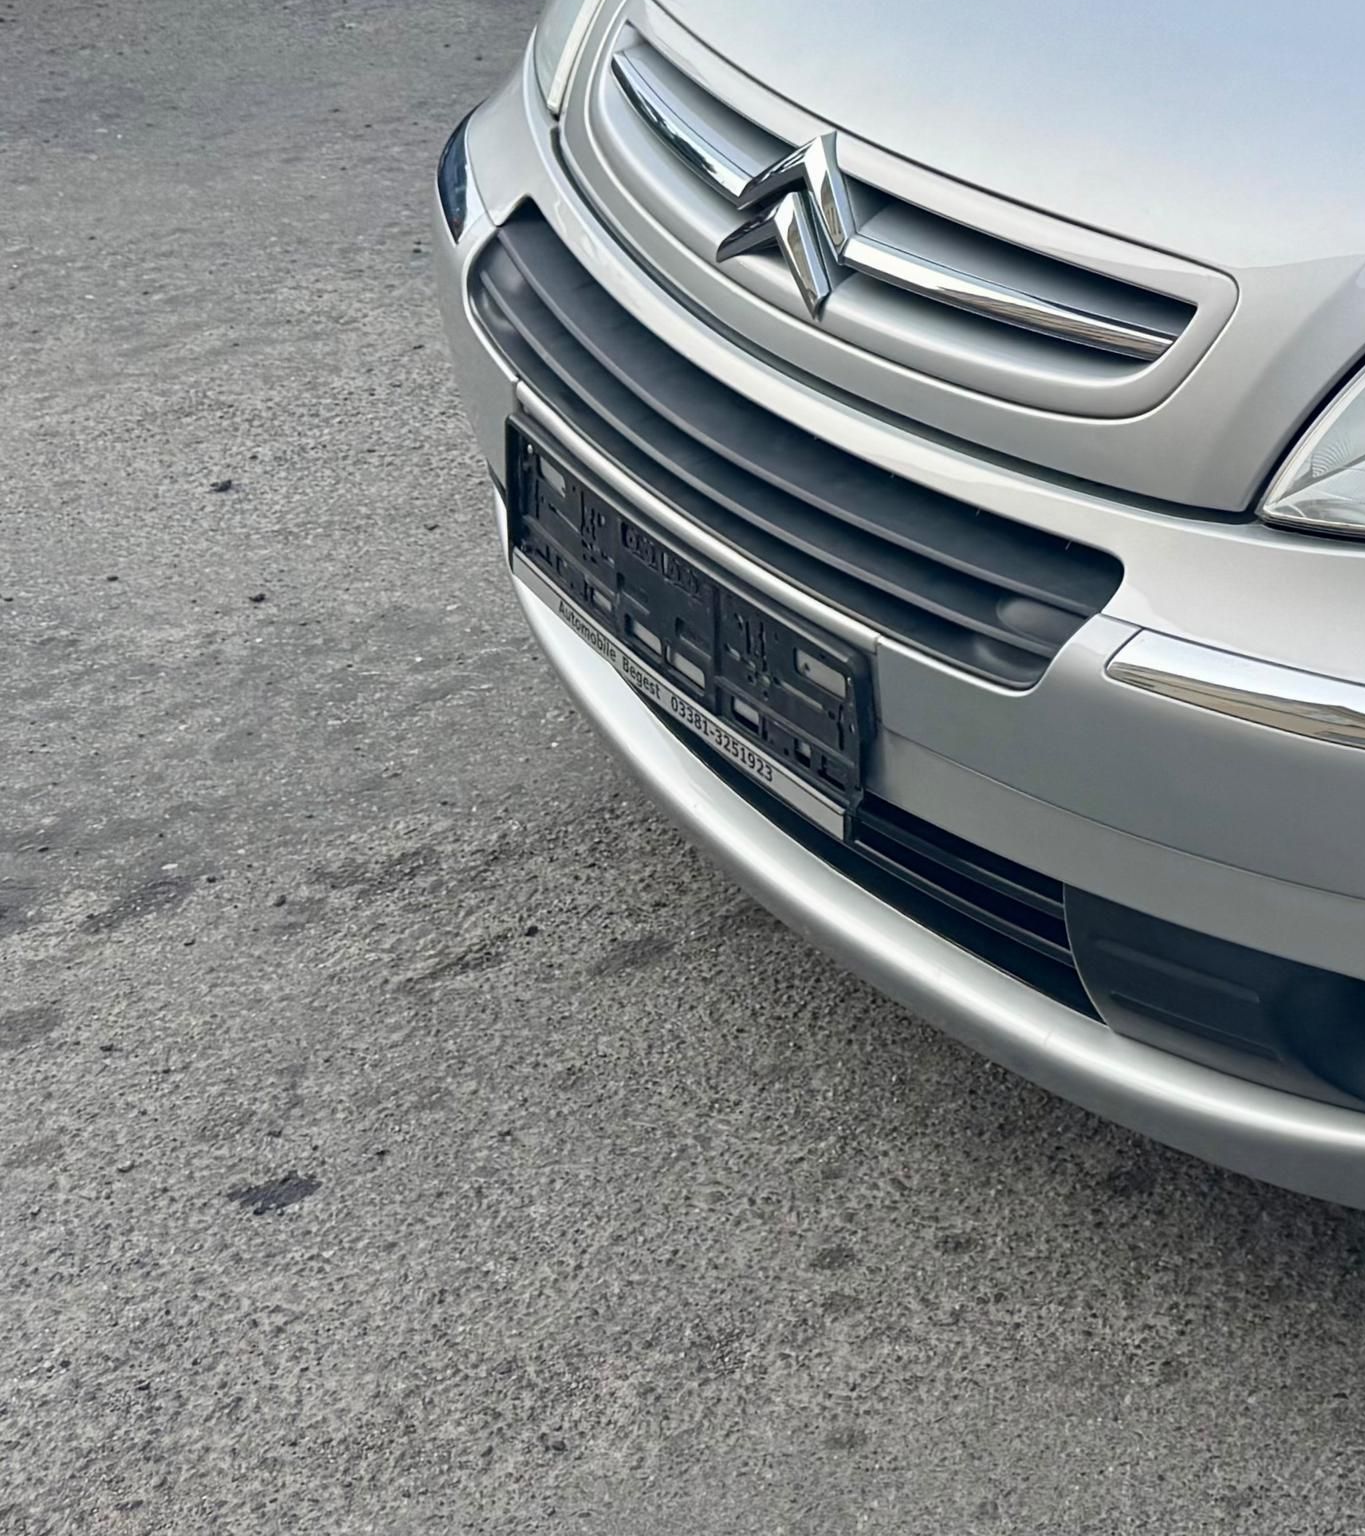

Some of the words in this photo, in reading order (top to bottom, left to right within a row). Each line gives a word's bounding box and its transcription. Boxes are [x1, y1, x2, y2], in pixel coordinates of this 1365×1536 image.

[558, 601, 617, 663] Automobile
[622, 657, 661, 701] Begest
[671, 695, 774, 782] 03381-3251923
